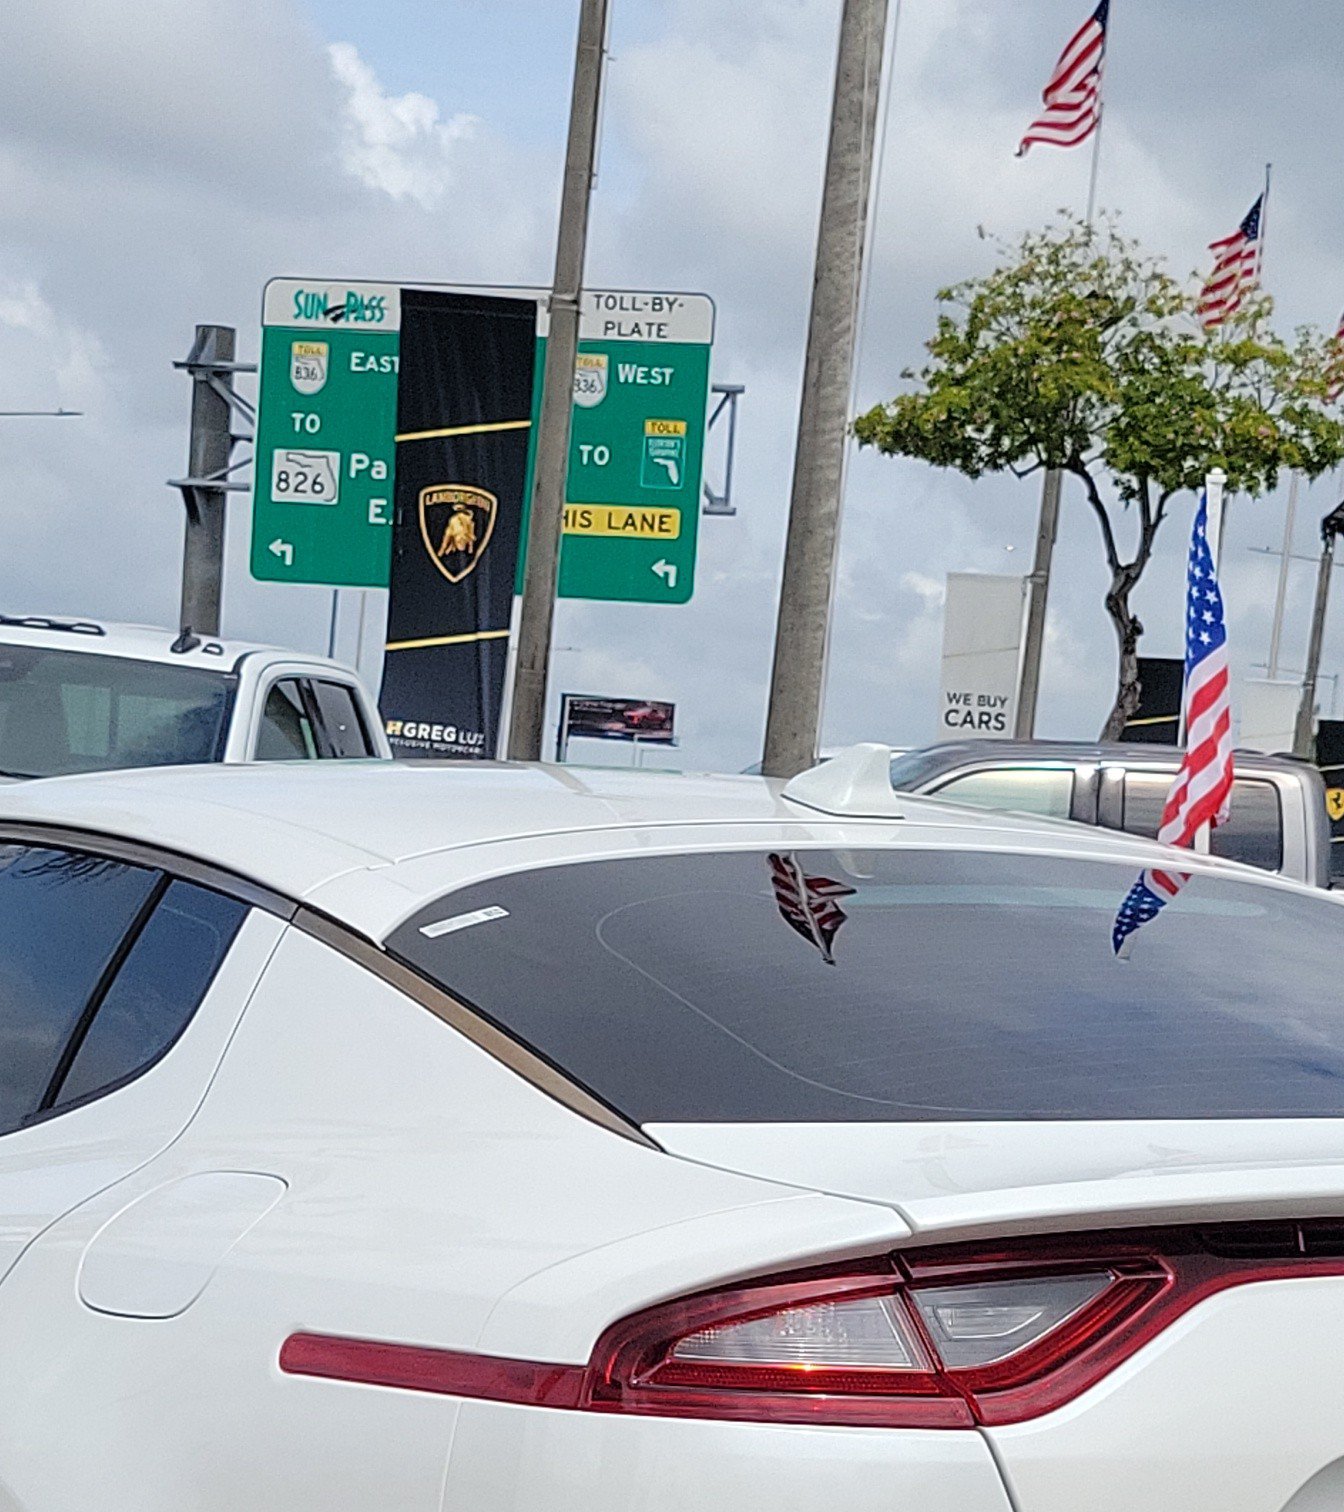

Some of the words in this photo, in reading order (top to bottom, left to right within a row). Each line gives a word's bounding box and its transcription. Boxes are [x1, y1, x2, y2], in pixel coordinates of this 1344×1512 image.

[594, 294, 684, 313] TOLL-BY-
[603, 321, 669, 339] PLATE
[350, 352, 399, 374] EAST
[617, 363, 674, 386] WEST
[290, 412, 321, 434] TO
[651, 422, 680, 434] TOLL
[579, 444, 610, 466] TO
[276, 470, 325, 494] 826
[562, 508, 594, 529] HIS
[607, 511, 673, 533] LANE
[946, 692, 974, 706] WE
[977, 694, 1009, 709] BUY
[944, 708, 1007, 731] CARS
